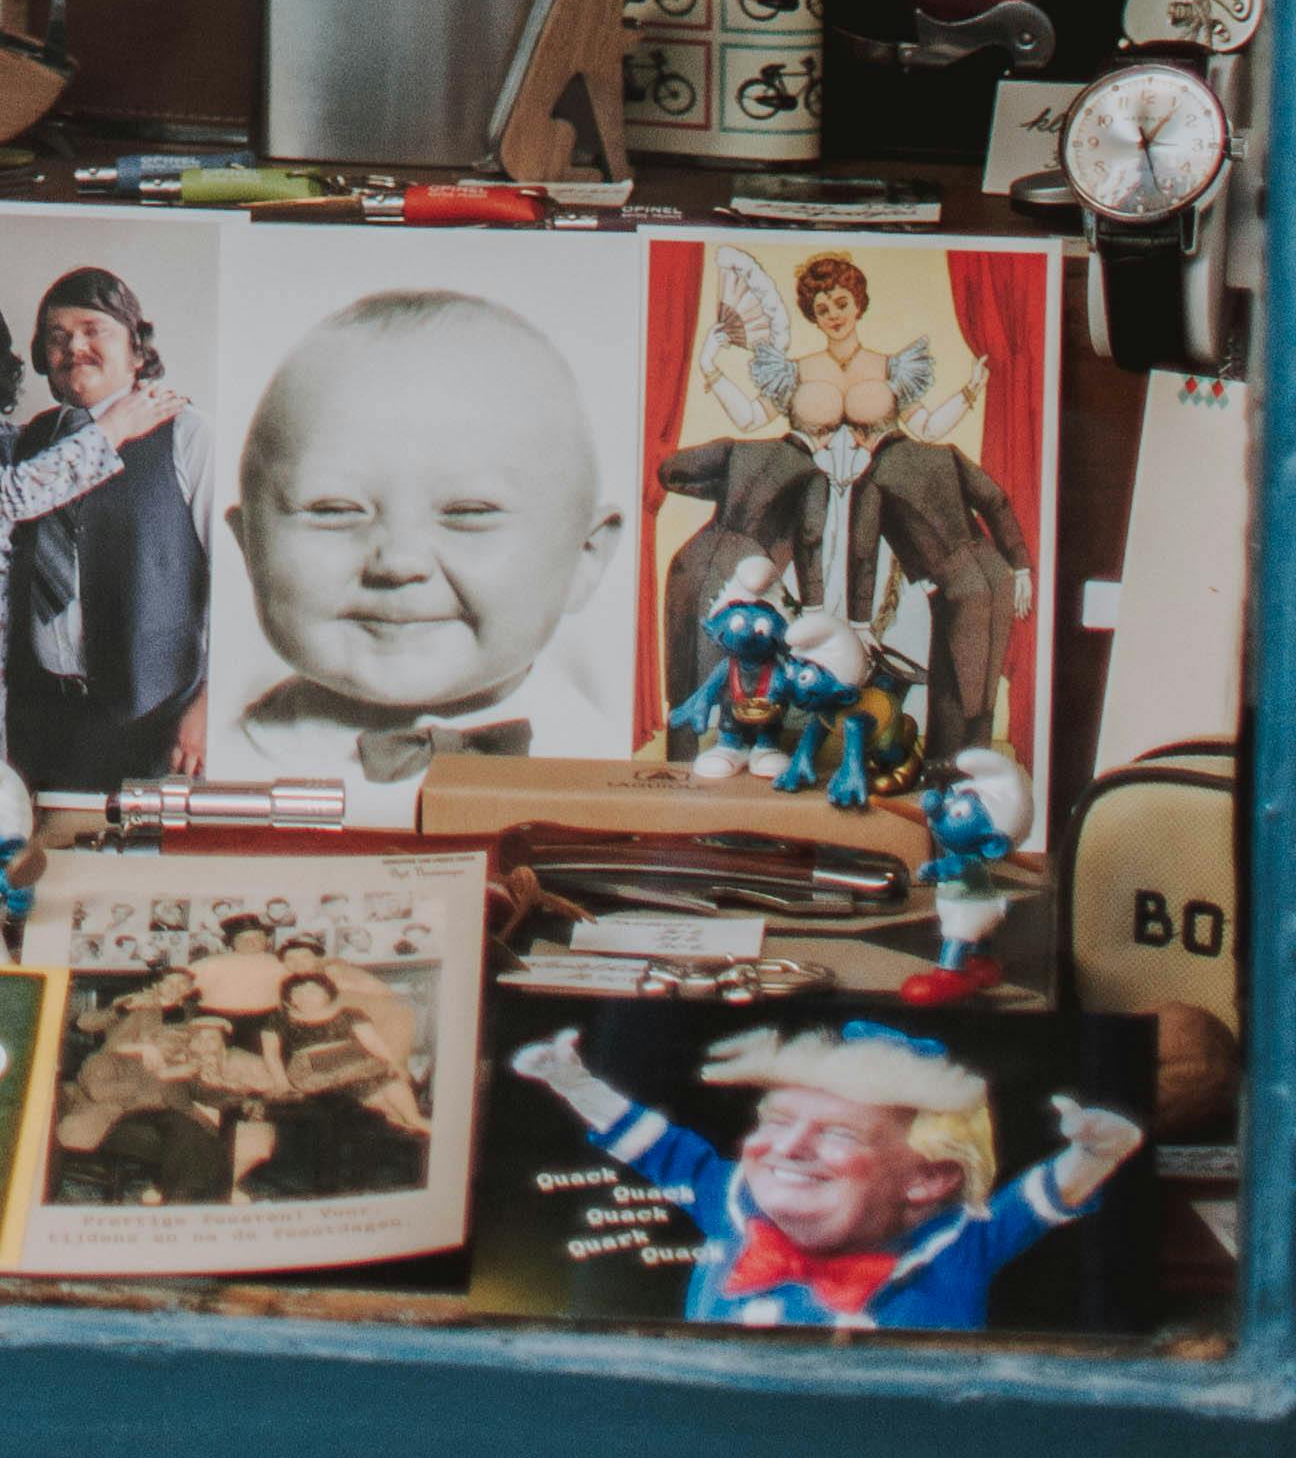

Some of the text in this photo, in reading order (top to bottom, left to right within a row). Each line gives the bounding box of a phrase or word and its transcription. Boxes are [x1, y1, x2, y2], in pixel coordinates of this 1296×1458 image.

[535, 1167, 619, 1194] Quack
[612, 1183, 696, 1205] Quack
[585, 1206, 669, 1228] Quack
[640, 1240, 724, 1268] Quack
